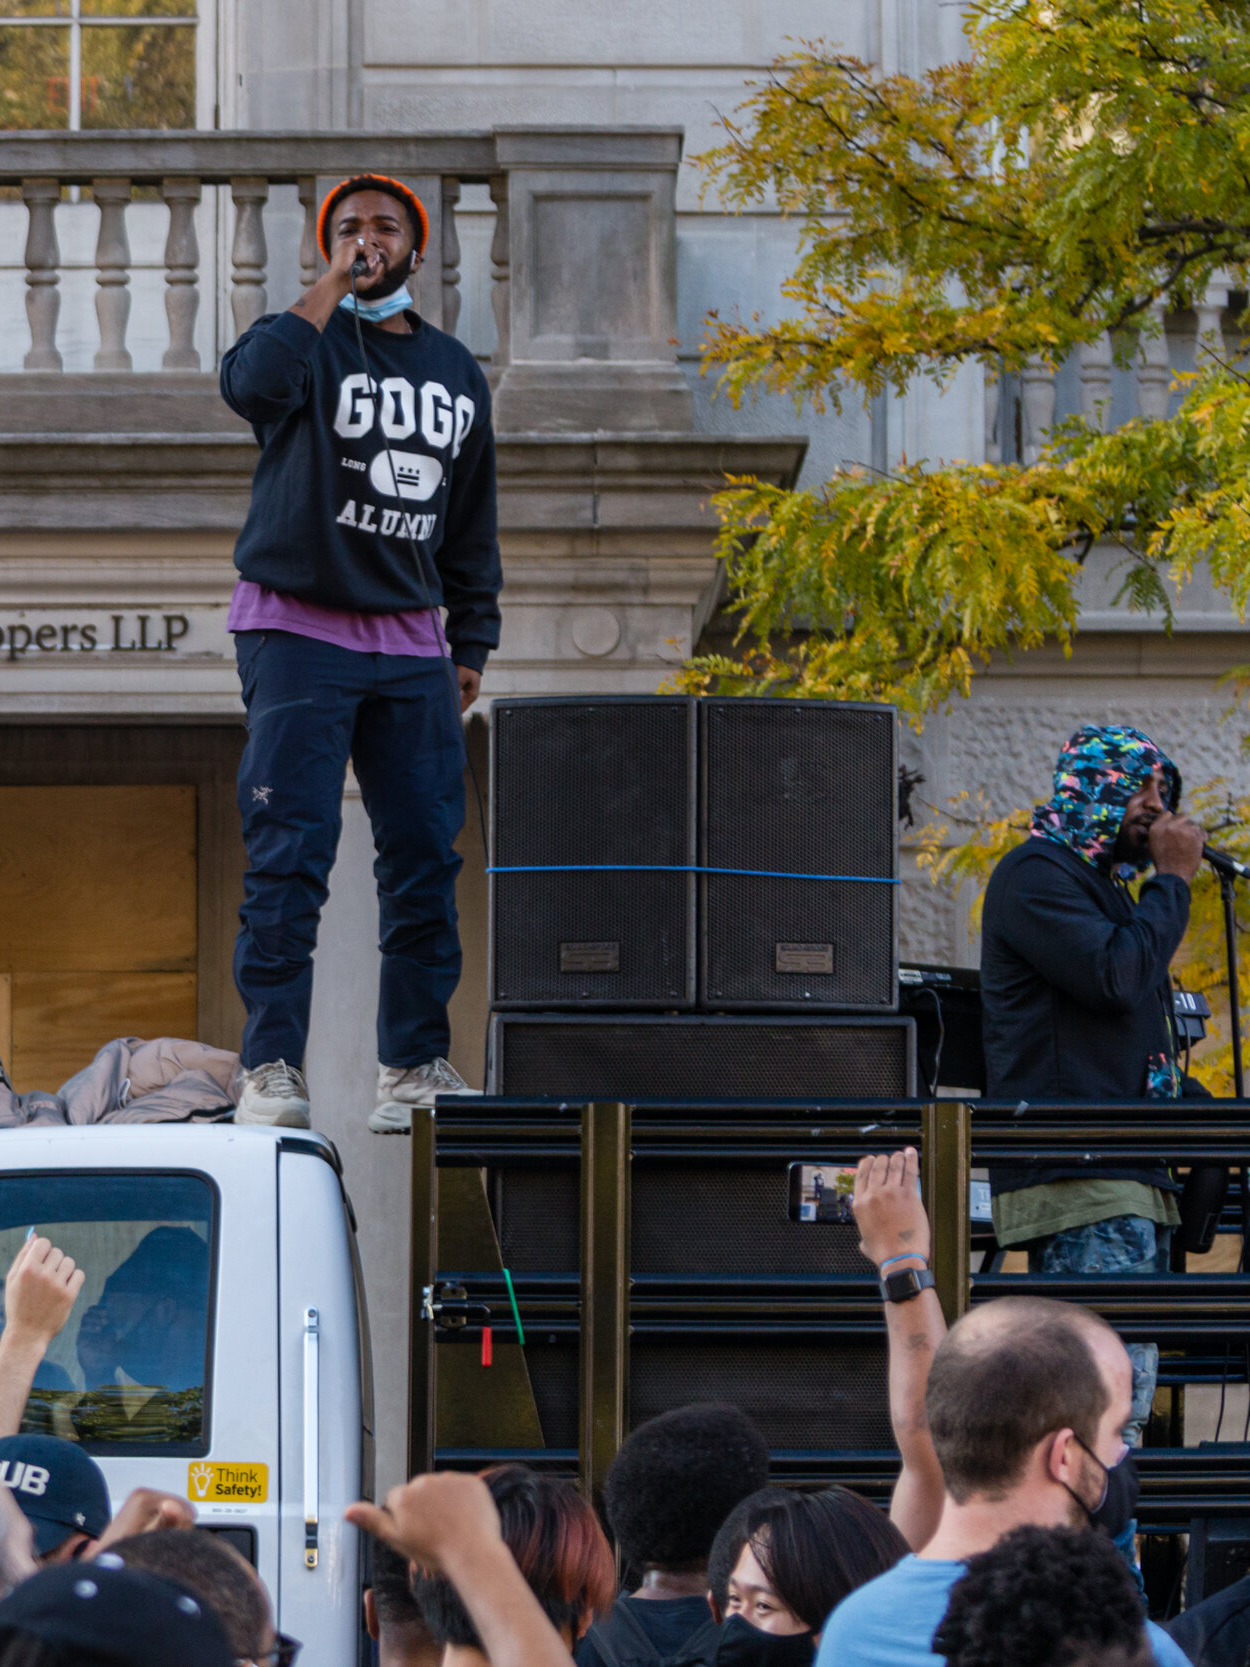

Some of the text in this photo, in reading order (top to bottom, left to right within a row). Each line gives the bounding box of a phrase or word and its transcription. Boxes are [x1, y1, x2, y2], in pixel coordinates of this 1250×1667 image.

[333, 372, 475, 459] GOGO
[340, 457, 367, 472] LONG
[110, 614, 189, 652] LLP
[216, 1468, 258, 1483] Think
[215, 1483, 262, 1497] Safety!
